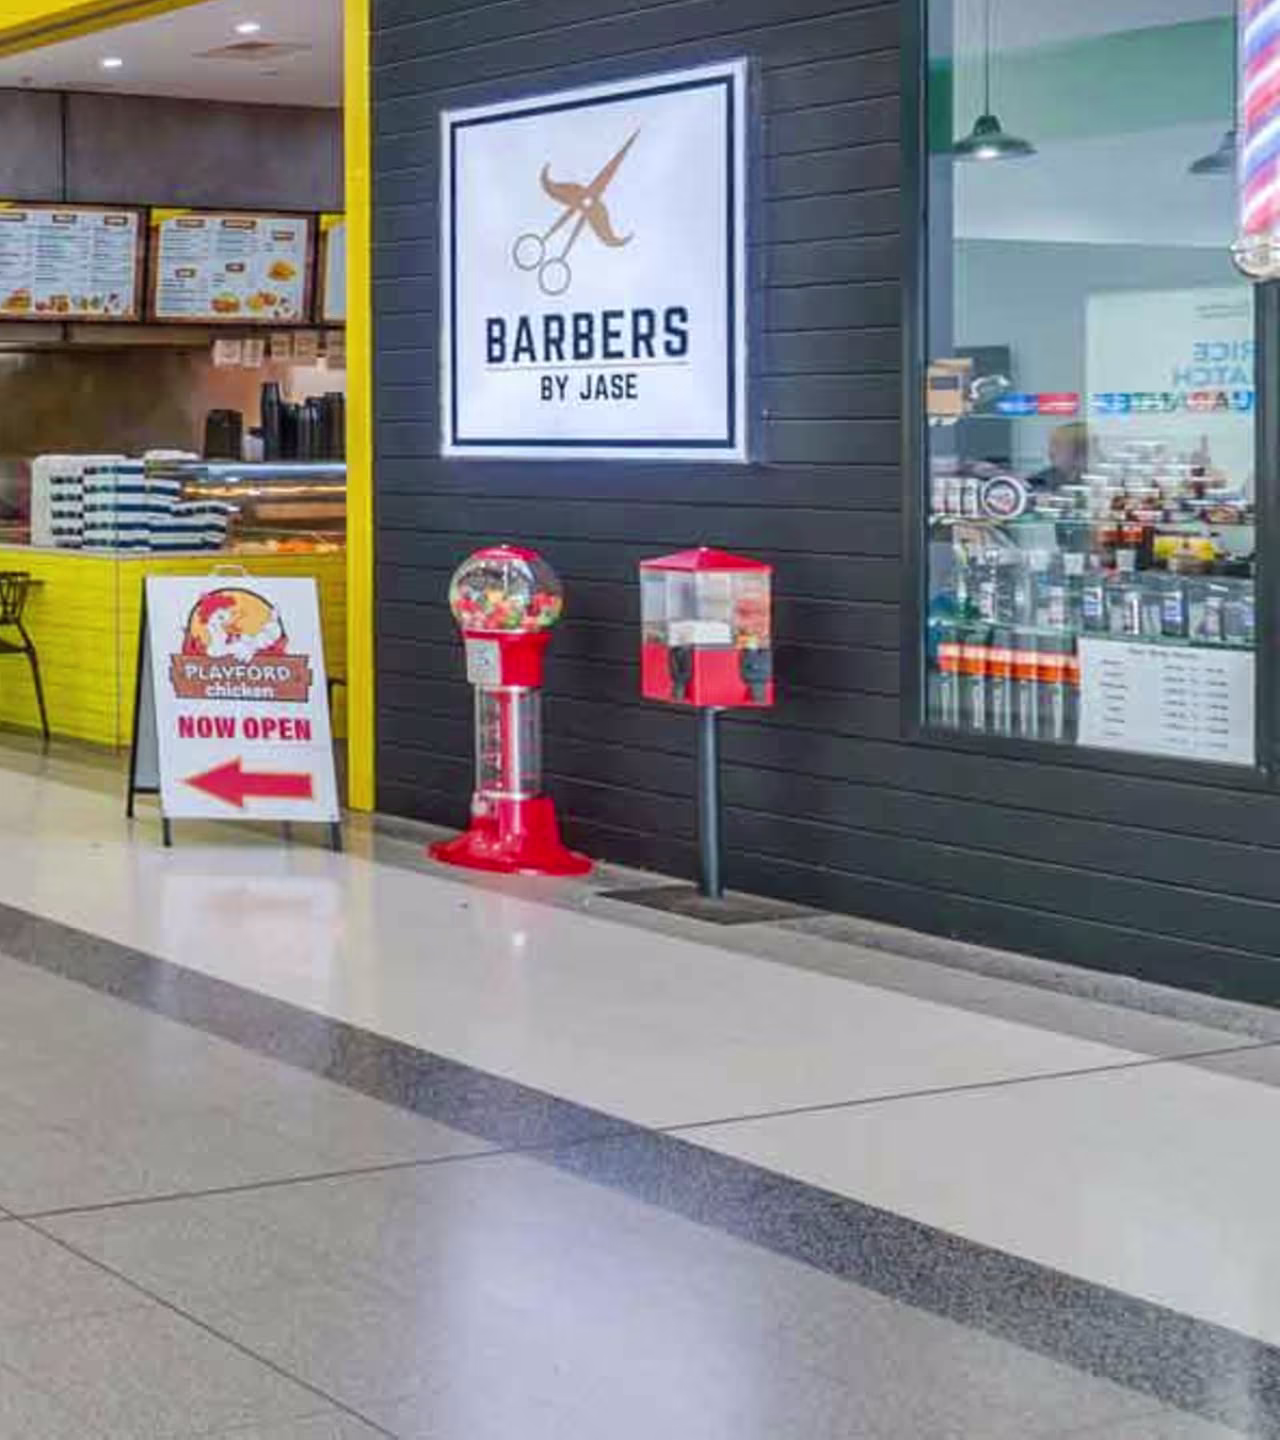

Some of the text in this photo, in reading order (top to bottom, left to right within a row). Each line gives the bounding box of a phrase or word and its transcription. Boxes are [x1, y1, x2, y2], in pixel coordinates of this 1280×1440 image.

[485, 305, 689, 365] BARBERS
[541, 372, 639, 402] BY JASE
[184, 665, 290, 681] PLAYFORD
[205, 681, 275, 698] chicken
[178, 716, 312, 741] NOW OPEN
